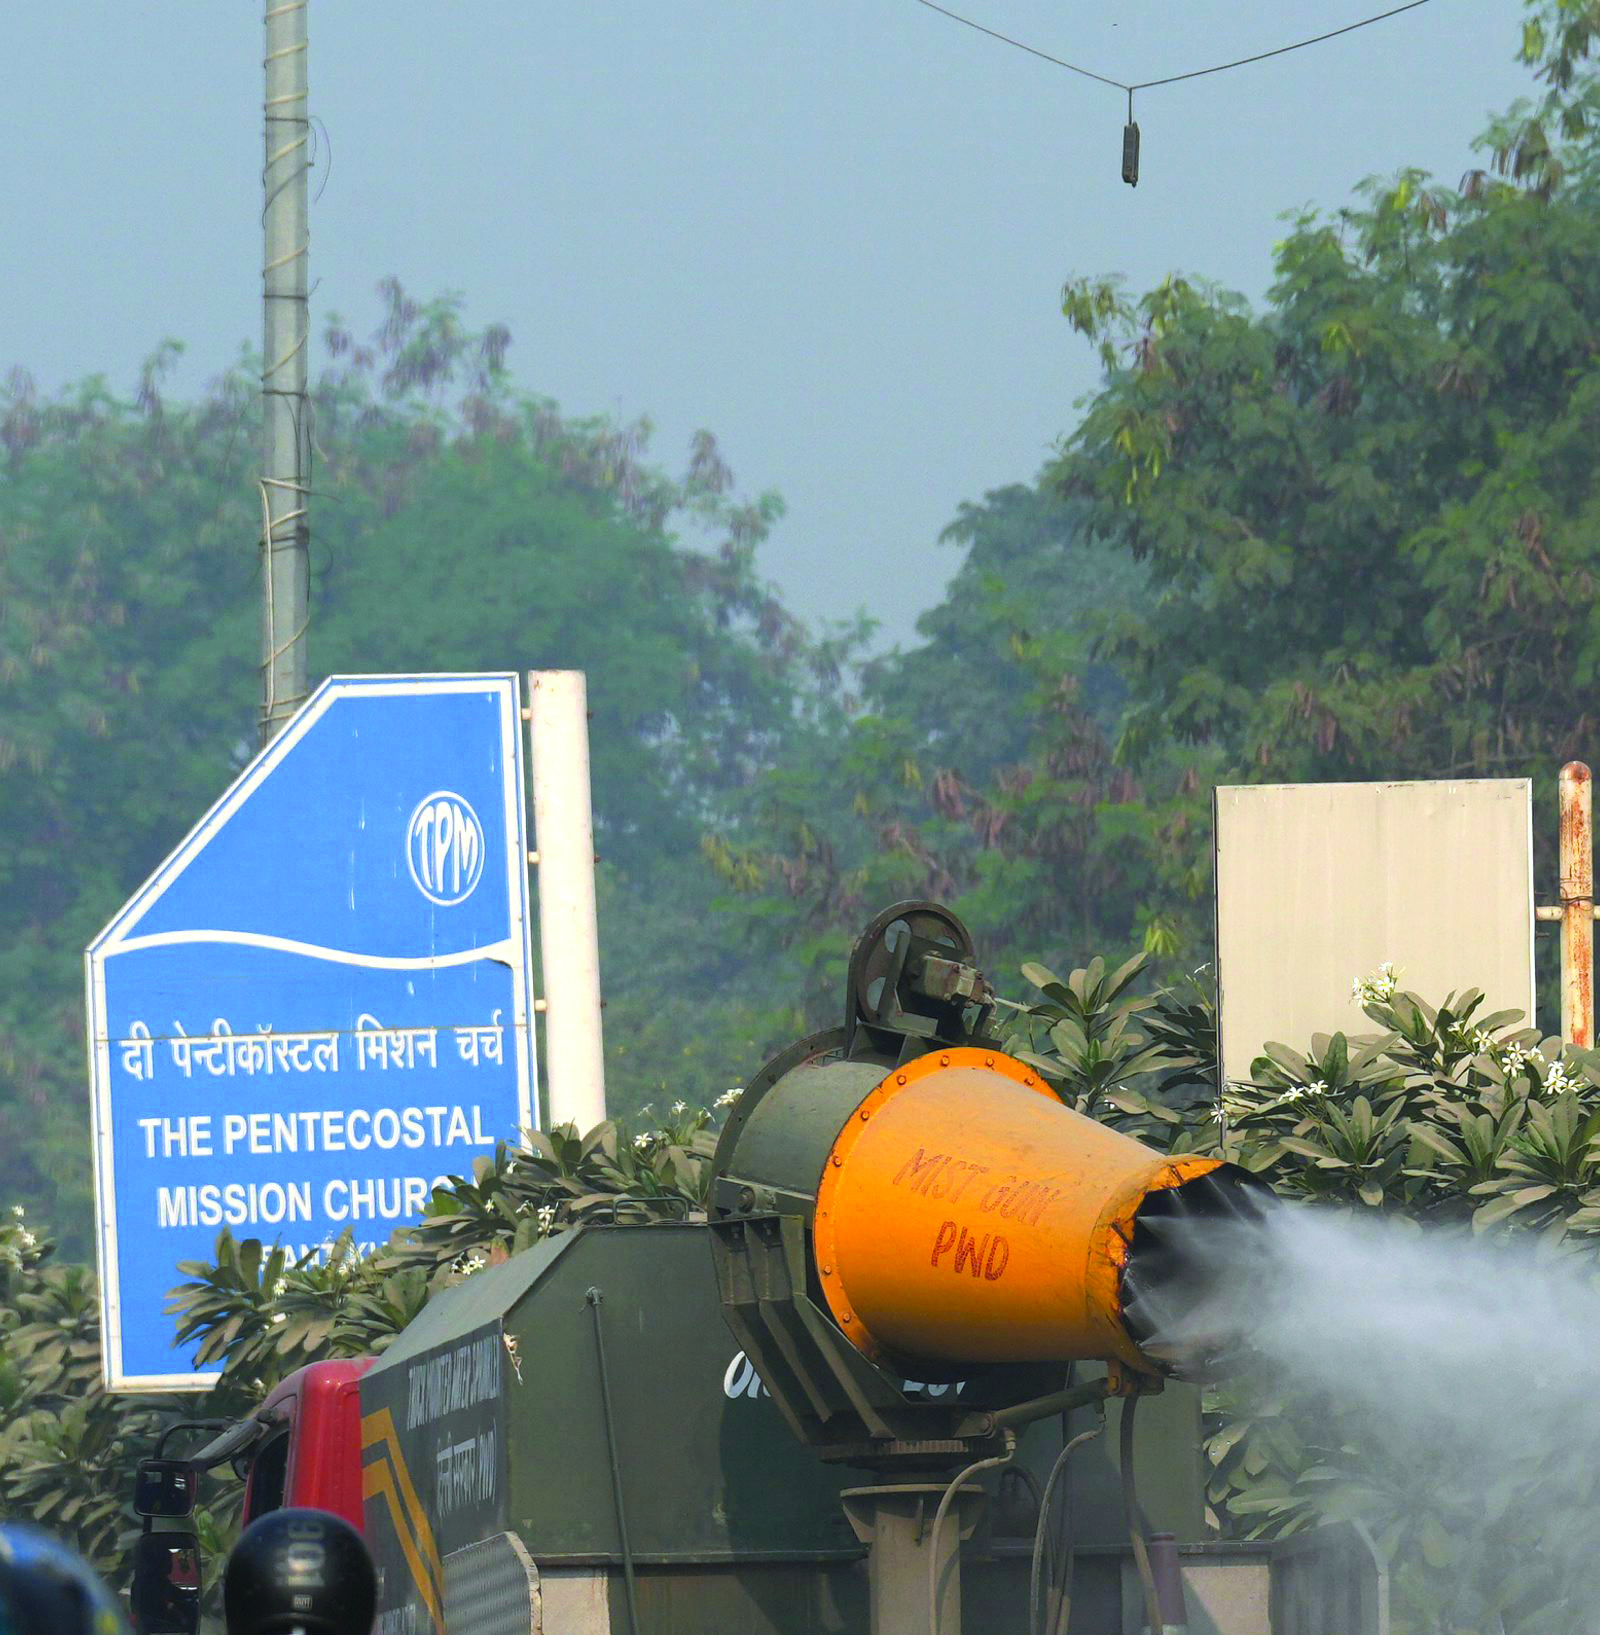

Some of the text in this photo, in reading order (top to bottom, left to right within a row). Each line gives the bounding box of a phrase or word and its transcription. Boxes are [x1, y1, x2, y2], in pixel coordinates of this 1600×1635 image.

[415, 801, 479, 893] TPM
[118, 1009, 504, 1080] दी पेन्टीकॉस्टल मिशन चर्च
[138, 1105, 495, 1158] THE PENTECOSTAL
[157, 1175, 481, 1228] MISSION CHUR
[892, 1147, 990, 1204] MIST
[931, 1220, 1010, 1281] PWD
